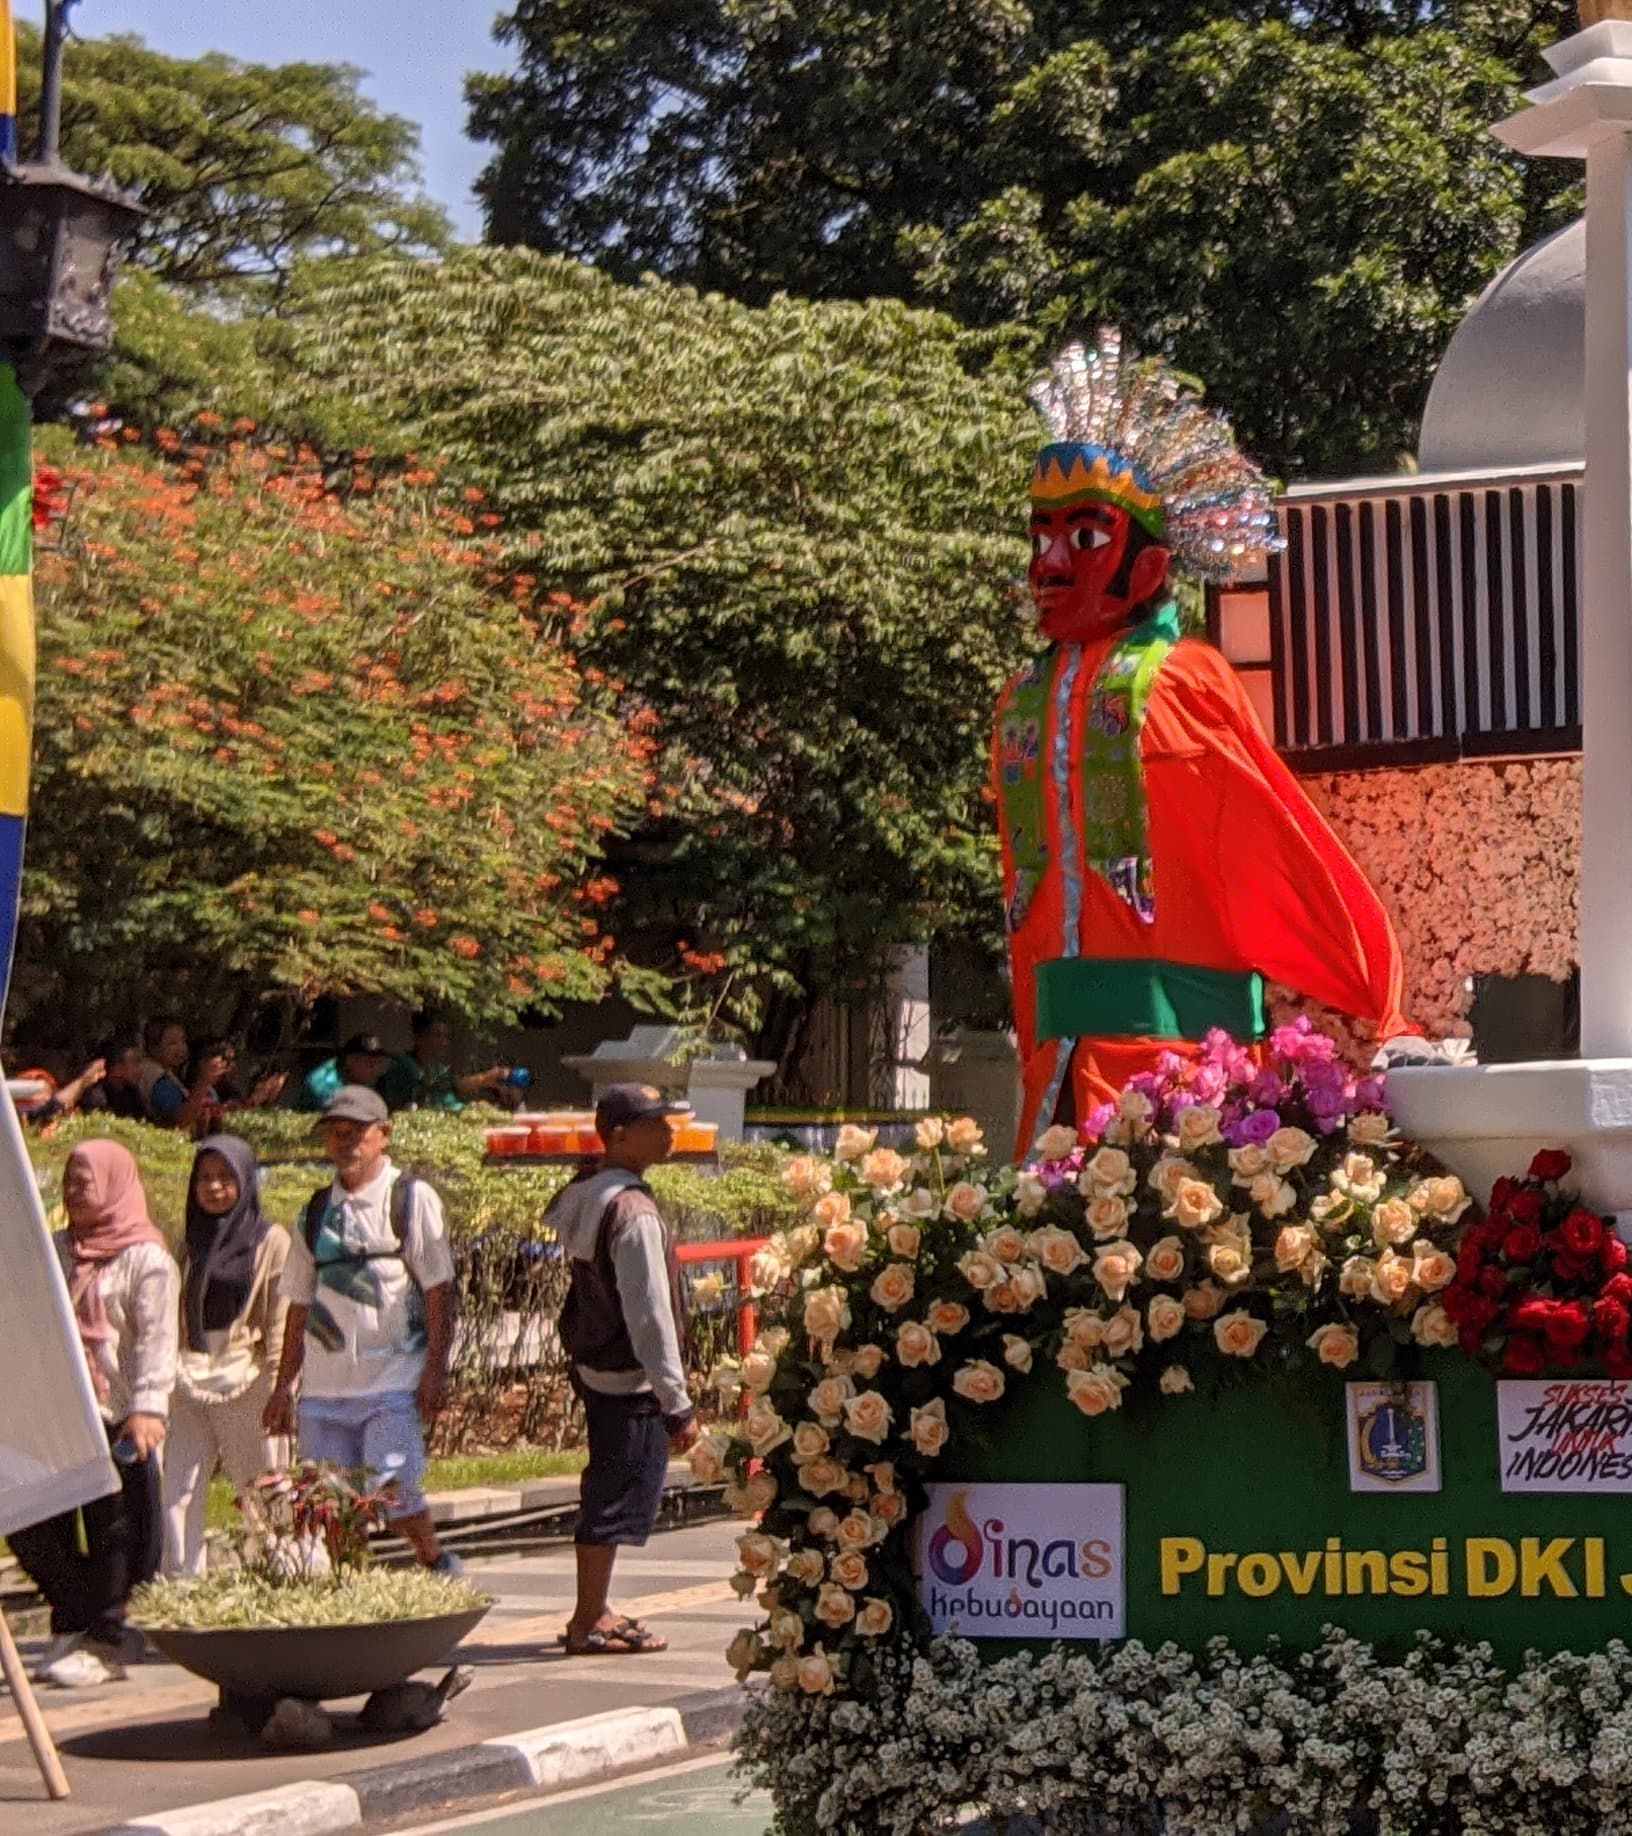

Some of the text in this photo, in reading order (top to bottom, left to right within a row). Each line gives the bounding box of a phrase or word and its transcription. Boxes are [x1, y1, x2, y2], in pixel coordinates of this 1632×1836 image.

[1542, 1384, 1628, 1405] SUKSES
[1551, 1429, 1622, 1457] UNTUK
[1160, 1537, 1449, 1597] Provinsi
[1466, 1537, 1606, 1597] DKI
